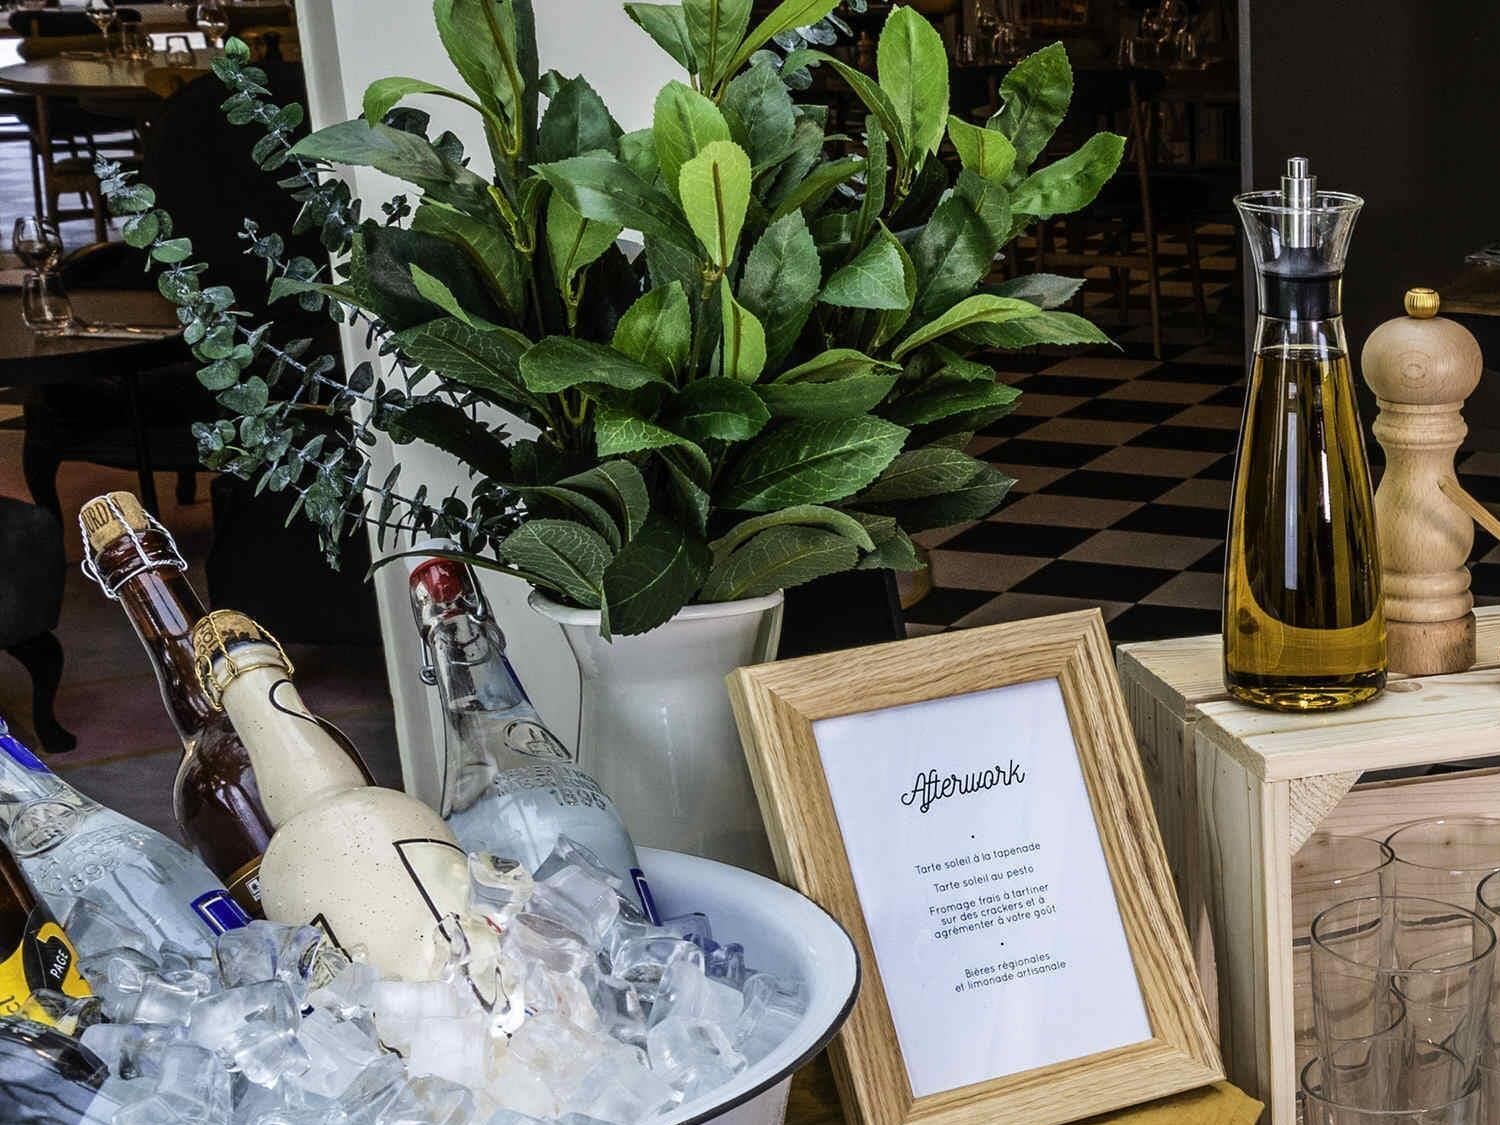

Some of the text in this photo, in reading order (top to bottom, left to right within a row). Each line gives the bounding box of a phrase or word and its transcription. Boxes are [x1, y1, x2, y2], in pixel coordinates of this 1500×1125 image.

[901, 759, 1026, 813] Afterwork
[914, 842, 1041, 875] Tarte soleil à la tapenade
[934, 865, 1035, 894] Tarte soleil au pesto
[929, 900, 976, 916] Fromage
[979, 893, 1001, 906] frais
[1012, 883, 1049, 899] tartiner
[941, 916, 957, 926] sur
[960, 910, 979, 922] des
[981, 901, 1024, 918] crackers
[1025, 897, 1036, 908] et
[934, 904, 1057, 940] agrémenter à votre goût
[50, 949, 70, 980] PAGE
[955, 960, 1067, 993] et limonade artisanale
[964, 952, 1051, 979] Bières régionales
